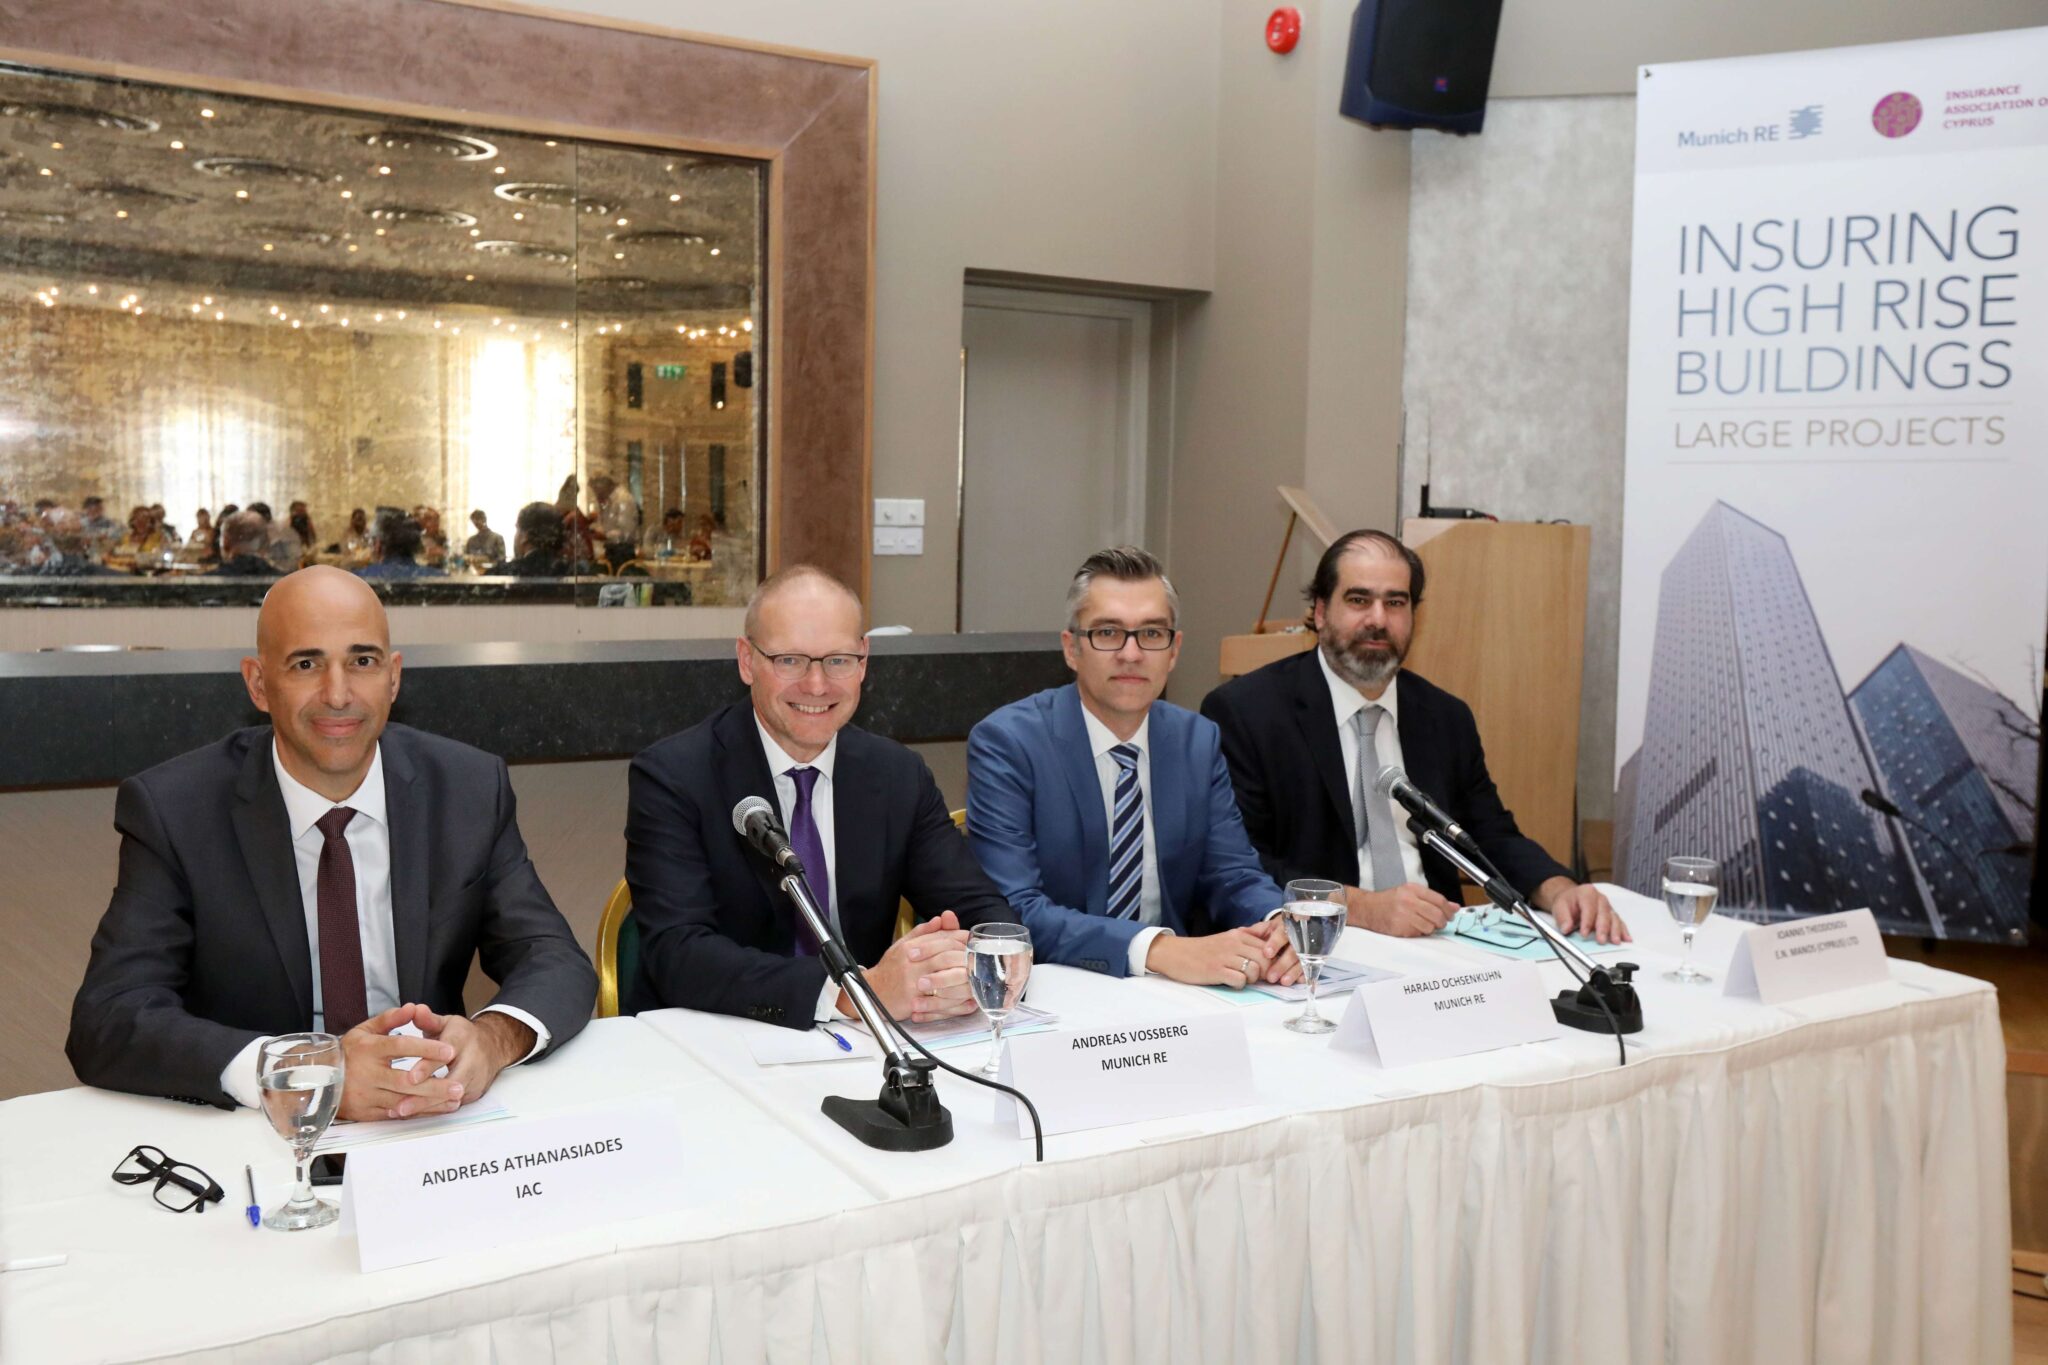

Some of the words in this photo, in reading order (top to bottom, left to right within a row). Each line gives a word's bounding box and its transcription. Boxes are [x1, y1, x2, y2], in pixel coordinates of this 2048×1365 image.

[1945, 84, 2021, 100] INSURANCE
[1944, 98, 2034, 114] ASSOCIATION
[2038, 97, 2048, 107] O
[1943, 117, 1995, 129] CYPRUS
[1677, 129, 1749, 147] Munich
[1754, 125, 1780, 142] RE
[1680, 205, 2019, 275] INSURING
[1677, 282, 1844, 338] HIGH
[1872, 274, 2019, 331] RISE
[1676, 340, 2012, 395] BUILDINGS
[1675, 421, 1792, 449] LARGE
[1806, 416, 2006, 447] PROJECTS
[1403, 980, 1440, 994] HARALD
[1441, 970, 1502, 988] OCHSENKUHN
[1434, 995, 1473, 1011] MUNICH
[1474, 993, 1486, 1004] RE
[1072, 1032, 1127, 1050] ANDREAS
[1129, 1025, 1189, 1043] VOSSBERG
[1101, 1054, 1151, 1071] MUNICH
[1153, 1051, 1168, 1064] RE
[422, 1160, 499, 1186] ANDREAS
[504, 1138, 623, 1171] ATHANASIADES
[516, 1182, 543, 1199] IAC
